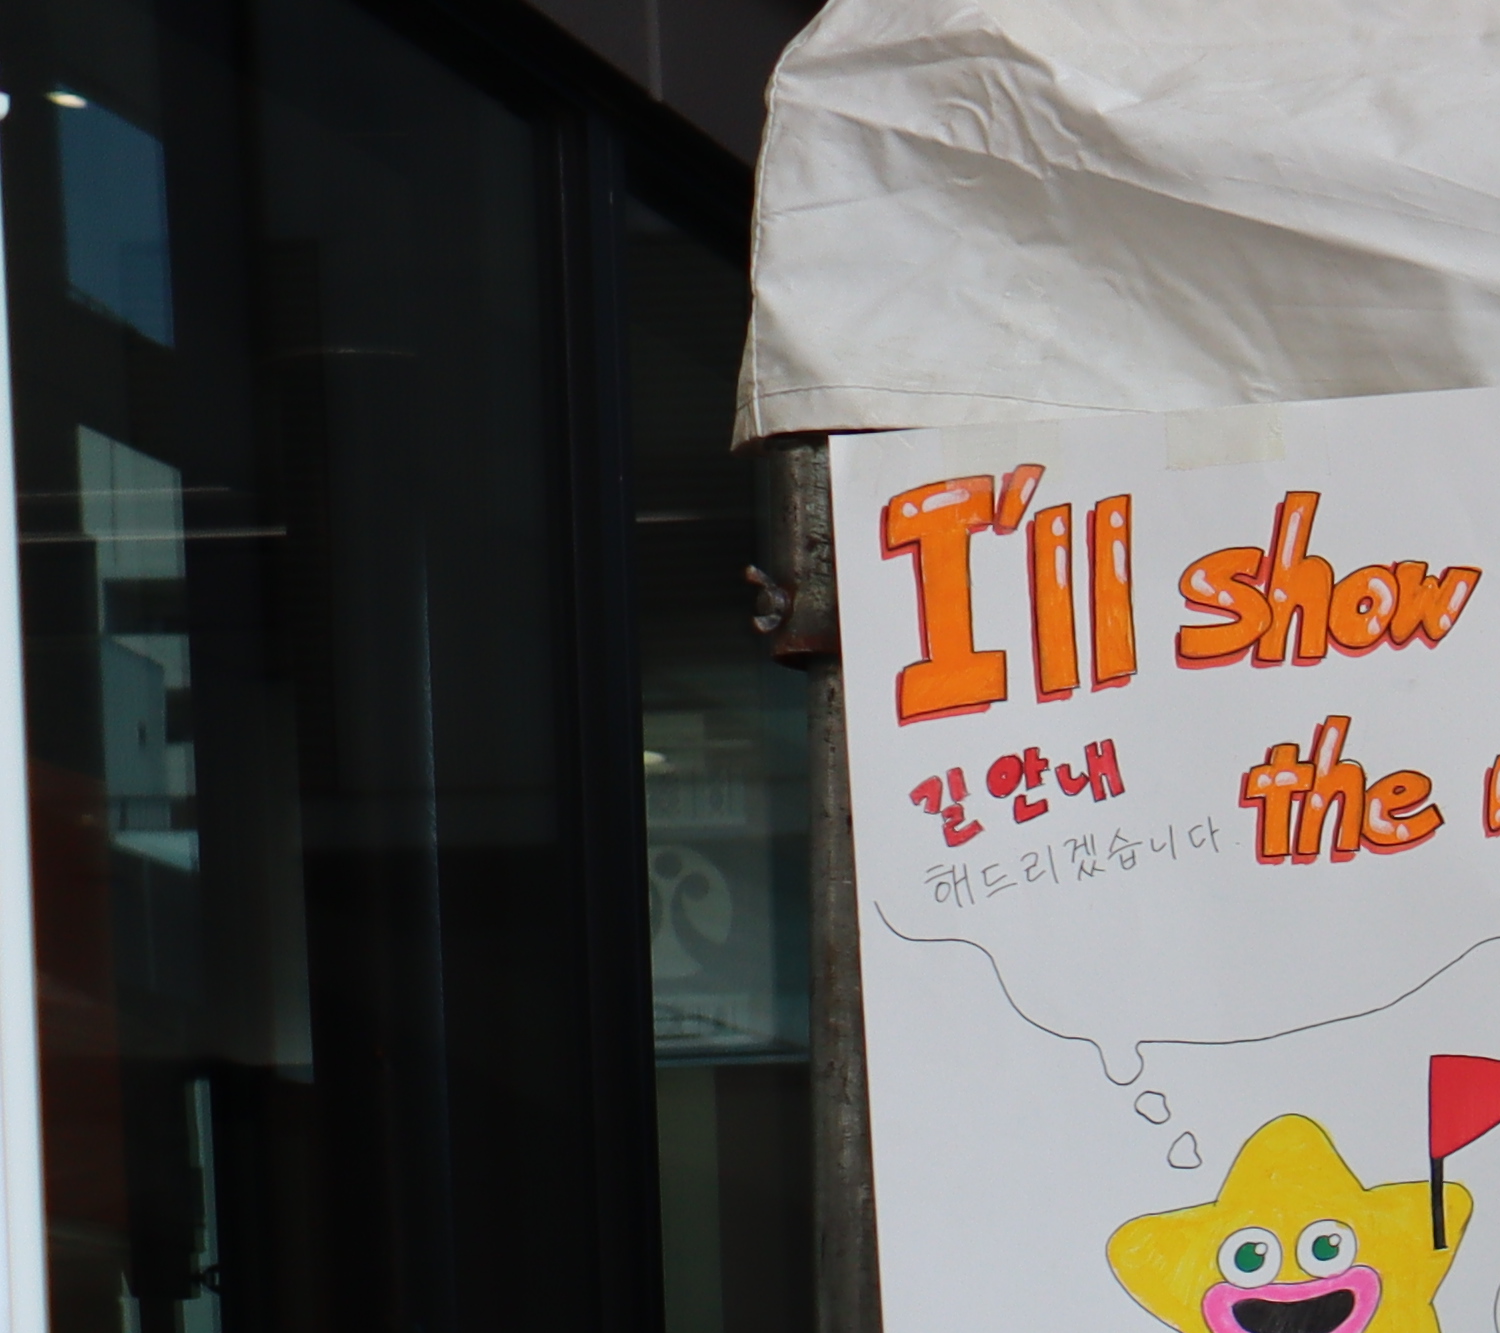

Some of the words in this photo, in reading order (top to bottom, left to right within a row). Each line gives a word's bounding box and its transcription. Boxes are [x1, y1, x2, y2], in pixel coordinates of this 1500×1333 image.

[881, 463, 1137, 728] I'll
[1176, 490, 1483, 669] show
[1241, 715, 1446, 867] the
